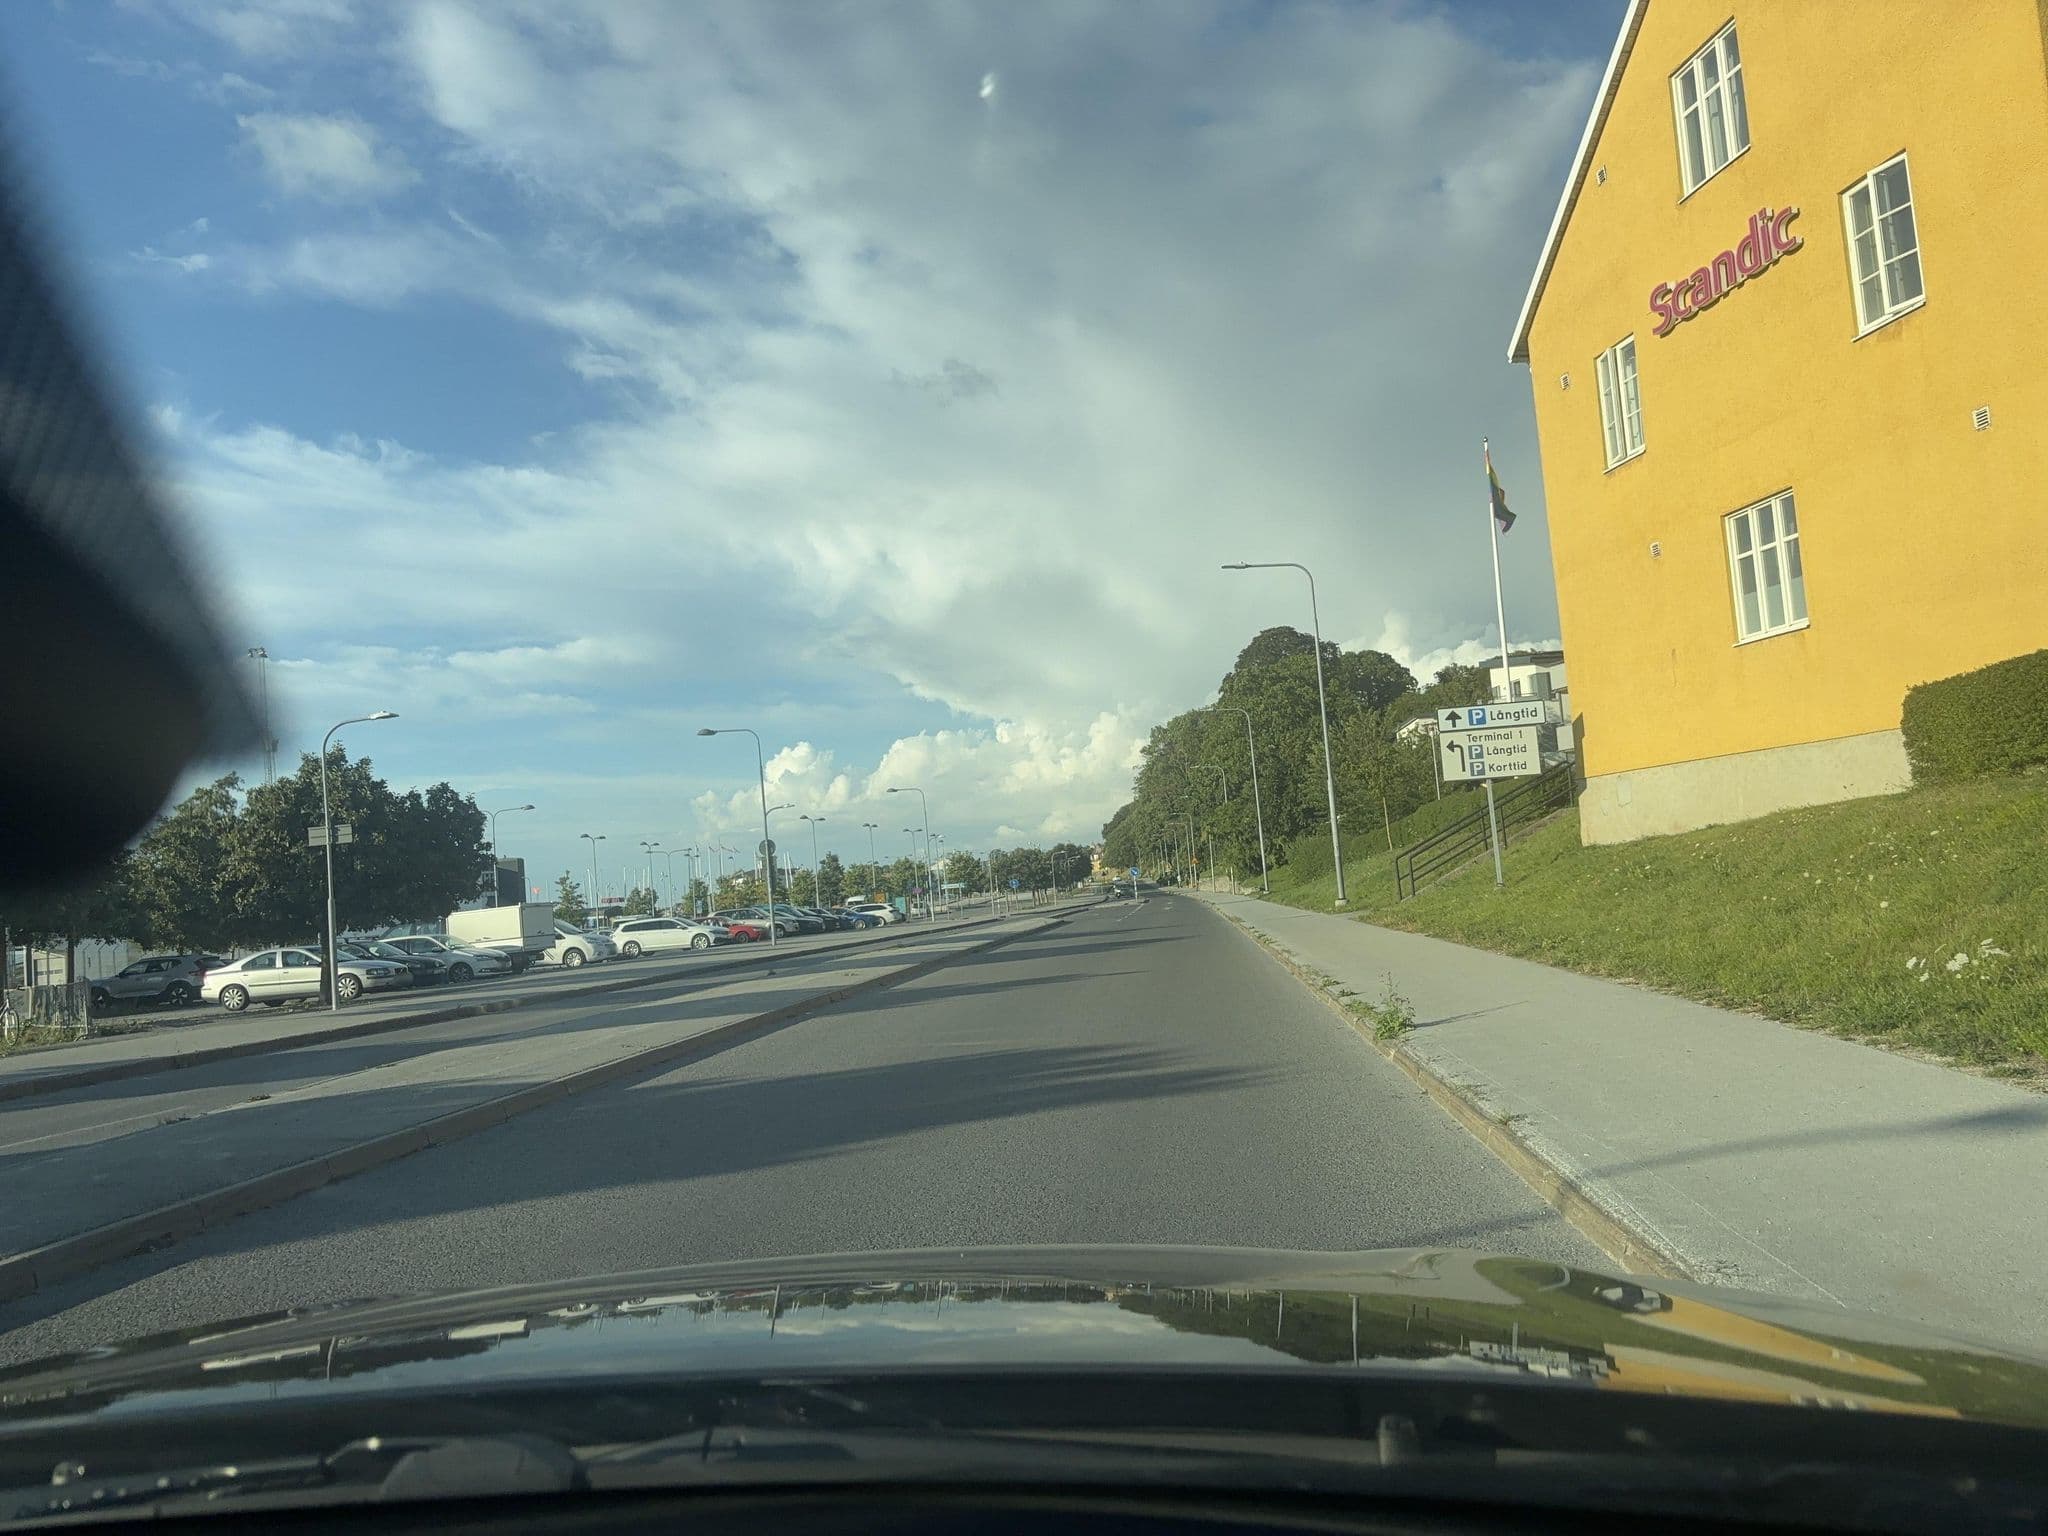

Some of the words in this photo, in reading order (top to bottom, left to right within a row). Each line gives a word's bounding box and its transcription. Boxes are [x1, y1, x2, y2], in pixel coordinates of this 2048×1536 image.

[1650, 206, 1801, 337] Scandic
[1471, 709, 1483, 725] P
[1490, 707, 1538, 721] Långtid
[1466, 731, 1513, 743] Terminal
[1471, 745, 1482, 759] P
[1487, 744, 1527, 756] Långtid
[1473, 762, 1483, 776] P
[1488, 761, 1527, 772] Korttid
